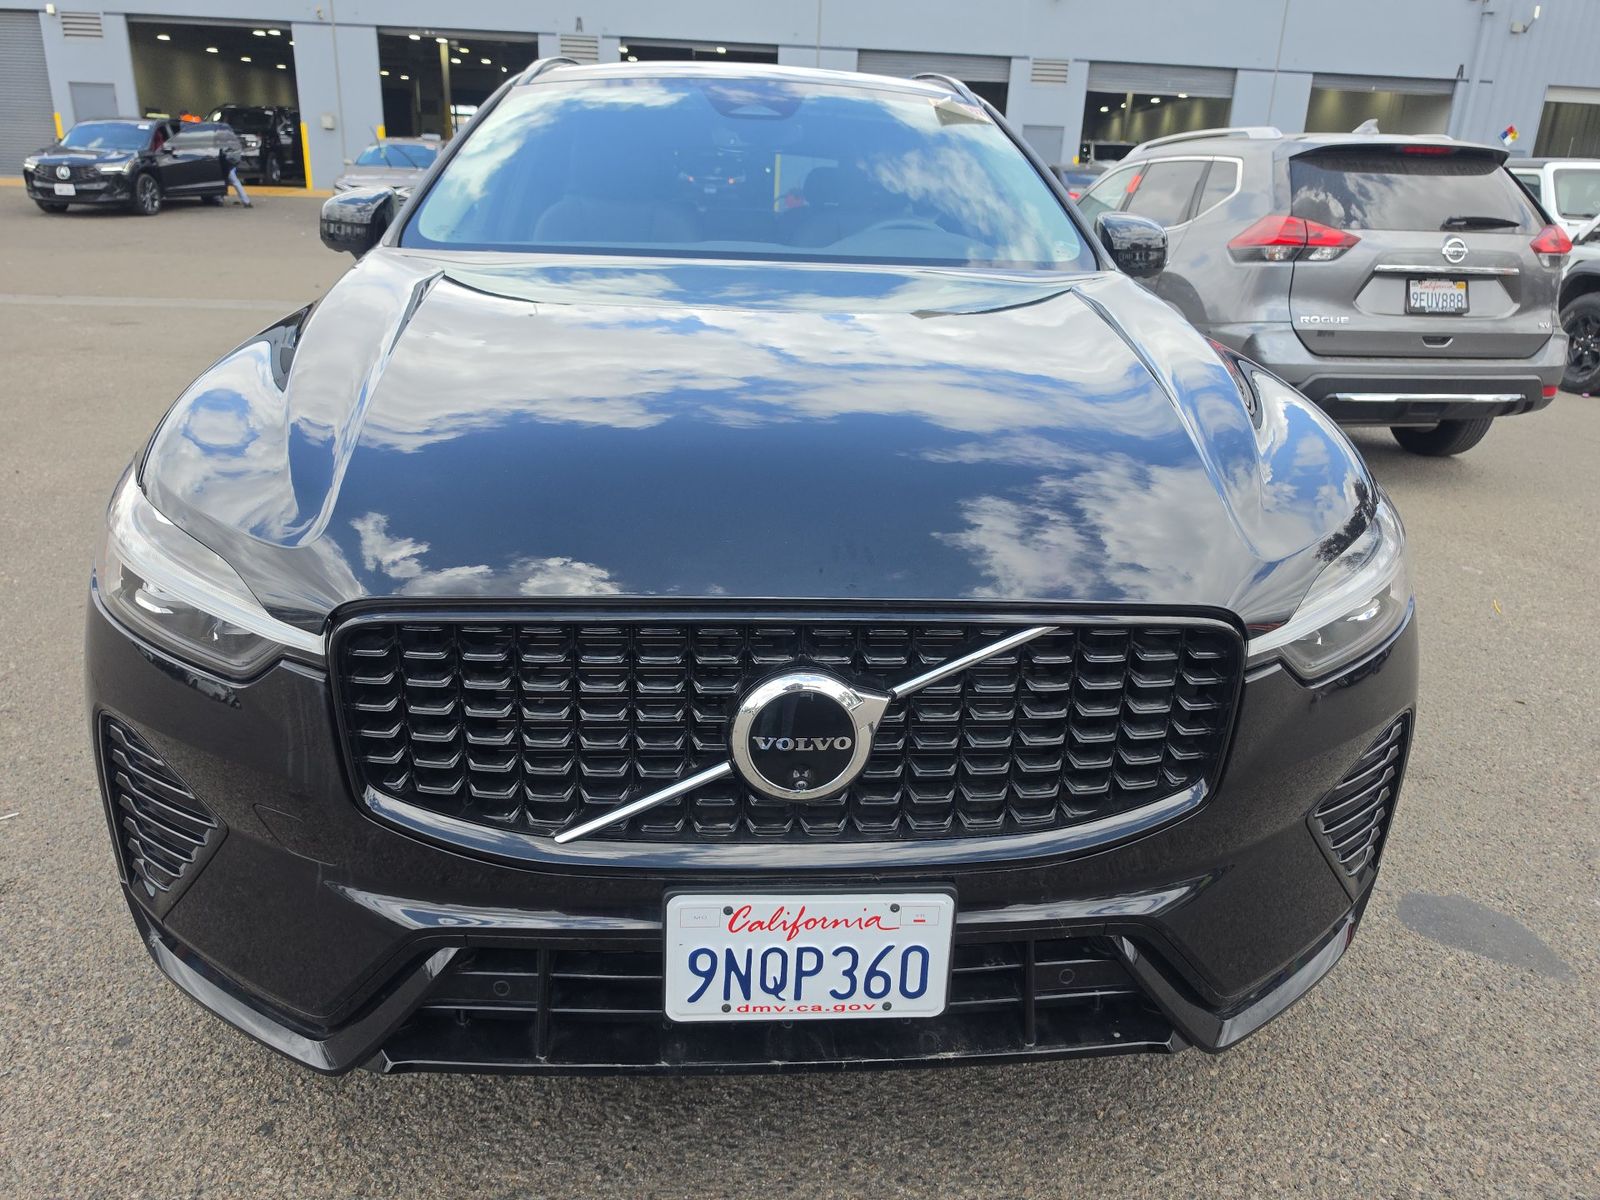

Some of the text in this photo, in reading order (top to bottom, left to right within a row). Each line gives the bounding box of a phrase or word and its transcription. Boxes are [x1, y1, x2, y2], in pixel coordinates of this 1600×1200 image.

[1300, 315, 1349, 324] ROGUE
[752, 736, 852, 751] VOLVO
[727, 905, 900, 941] California
[687, 944, 930, 1003] 9NQP360
[736, 1002, 877, 1014] dmv.ca.gov
